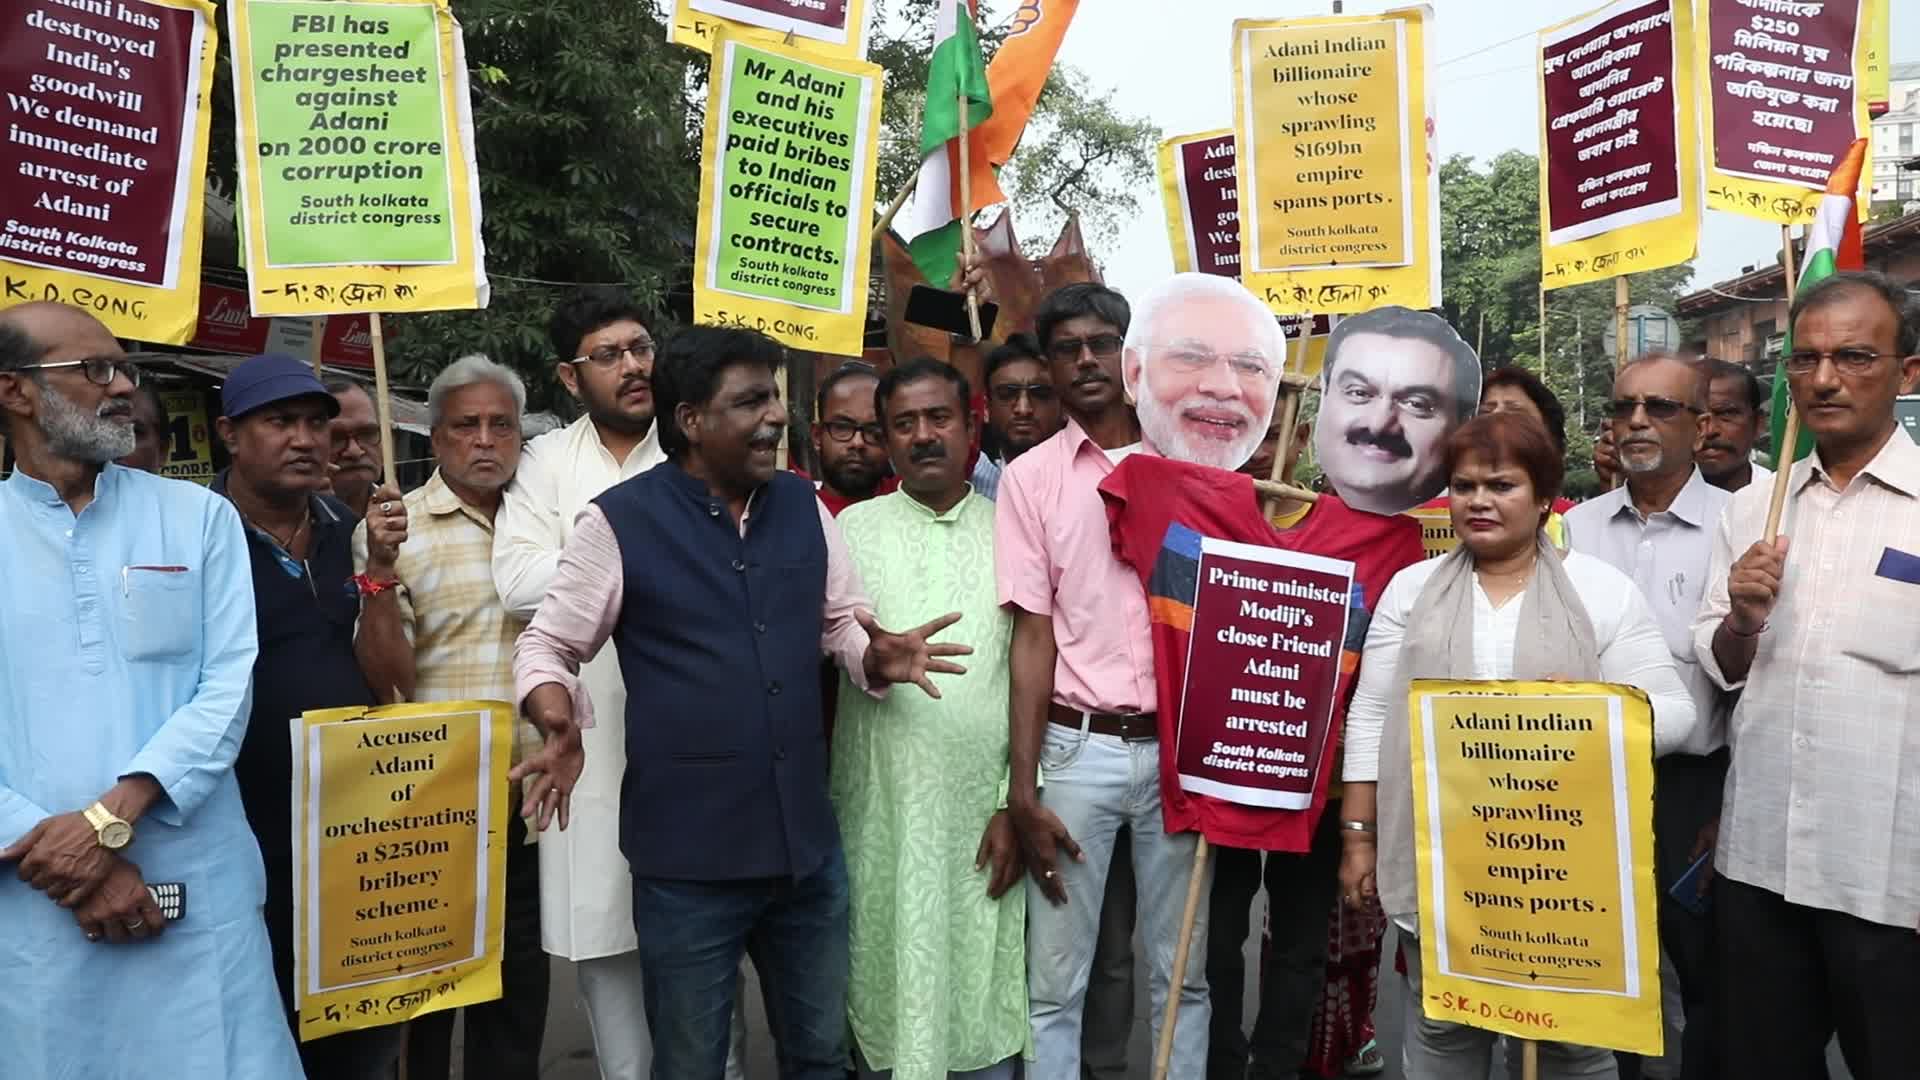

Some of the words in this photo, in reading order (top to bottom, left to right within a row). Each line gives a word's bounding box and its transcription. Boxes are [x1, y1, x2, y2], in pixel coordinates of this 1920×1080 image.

[48, 0, 112, 17] dani
[117, 3, 160, 30] has
[291, 15, 335, 33] FBI
[343, 15, 390, 35] has
[1751, 15, 1800, 36] $250
[26, 10, 156, 58] destroyed
[274, 40, 409, 62] presented
[1264, 40, 1319, 58] Adani
[1325, 36, 1386, 55] Indian
[46, 43, 131, 81] India's
[1272, 63, 1372, 83] billionaire
[260, 64, 427, 86] chargesheet
[743, 58, 776, 83] Mr
[779, 70, 845, 100] Adani
[29, 73, 143, 112] goodwill
[295, 88, 398, 111] against
[755, 87, 800, 112] and
[804, 96, 835, 120] his
[1298, 90, 1358, 107] whose
[1802, 95, 1839, 113] করা
[8, 93, 50, 119] We
[55, 107, 158, 144] demand
[309, 112, 389, 131] Adani
[731, 109, 850, 147] executives
[1281, 113, 1376, 137] sprawling
[9, 124, 148, 171] immediate
[259, 141, 290, 158] on
[298, 136, 367, 157] 2000
[373, 140, 442, 156] crore
[726, 131, 784, 155] paid
[786, 141, 850, 172] bribes
[1294, 140, 1362, 158] $169bn
[19, 161, 100, 190] arrest
[105, 178, 135, 197] of
[282, 160, 423, 184] corruption
[738, 158, 763, 178] to
[768, 162, 837, 193] Indian
[1296, 166, 1363, 186] empire
[33, 192, 111, 222] Adani
[300, 194, 354, 209] South
[358, 194, 429, 208] kolkata
[729, 181, 819, 214] officials
[825, 198, 848, 219] to
[1272, 194, 1327, 213] spans
[289, 210, 357, 226] district
[362, 213, 441, 228] congress
[749, 210, 820, 237] secure
[1287, 224, 1325, 238] South
[1328, 224, 1378, 237] kolkata
[5, 220, 62, 241] South
[66, 232, 138, 256] Kolkata
[731, 232, 840, 266] contracts.
[1279, 242, 1326, 256] district
[1330, 242, 1387, 257] congress
[66, 250, 147, 273] congress
[738, 256, 780, 274] South
[782, 263, 829, 282] kolkata
[730, 270, 780, 289] district
[782, 277, 836, 297] congress
[1209, 567, 1268, 592] Prime
[1272, 578, 1348, 605] minister
[1239, 600, 1313, 627] Modiji's
[1217, 626, 1268, 650] close
[1271, 633, 1331, 658] Friend
[1243, 658, 1300, 681] Adani
[1231, 687, 1280, 706] must
[1284, 690, 1306, 710] be
[1226, 714, 1308, 738] arrested
[1450, 713, 1510, 731] Adani
[1517, 714, 1593, 731] Indian
[356, 724, 448, 749] Accused
[1212, 741, 1254, 758] South
[1257, 746, 1305, 763] Kolkata
[1461, 741, 1576, 761] billionaire
[369, 754, 434, 775] Adani
[1202, 756, 1254, 773] district
[1257, 763, 1309, 778] congress
[390, 783, 416, 803] of
[1488, 774, 1559, 791] whose
[325, 808, 477, 839] orchestrating
[1472, 802, 1583, 827] sprawling
[356, 850, 369, 864] a
[373, 839, 450, 864] $250m
[1485, 831, 1566, 852] $169bn
[359, 869, 442, 893] bribery
[1487, 864, 1568, 884] empire
[1464, 888, 1524, 911] spans
[349, 932, 393, 949] South
[395, 925, 447, 942] kolkata
[1479, 925, 1522, 943] South
[1525, 931, 1589, 947] kolkata
[341, 951, 394, 969] district
[396, 939, 454, 959] congress
[1471, 943, 1525, 962] district
[1528, 950, 1601, 969] congress
